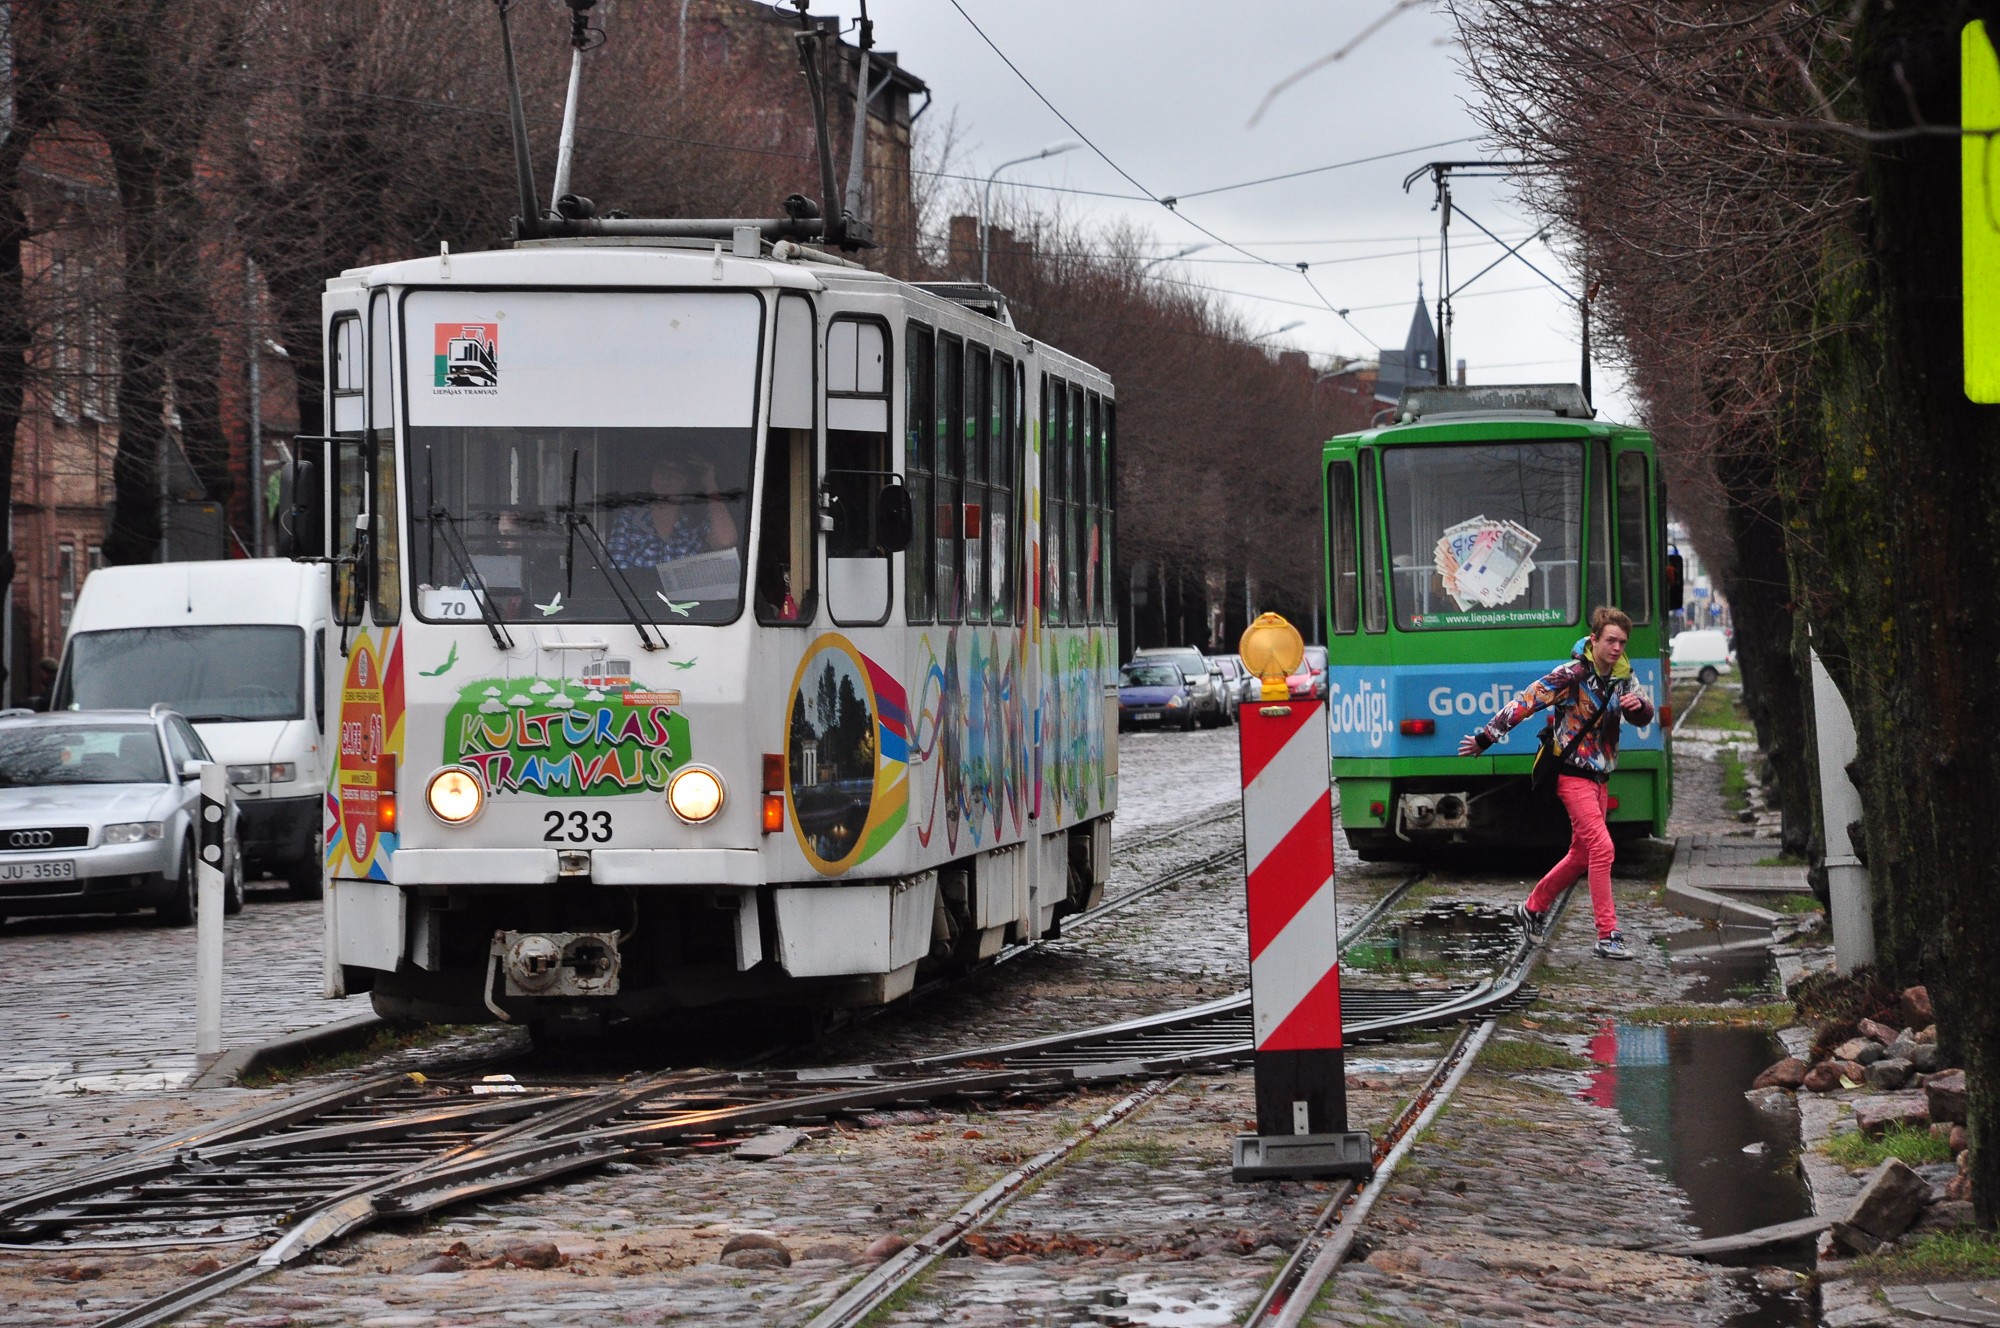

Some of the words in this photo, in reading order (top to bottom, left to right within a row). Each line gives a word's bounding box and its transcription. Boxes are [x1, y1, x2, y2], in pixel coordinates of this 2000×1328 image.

[441, 602, 466, 616] 70
[1445, 610, 1561, 625] www.liepajas-tramvajs.lv
[459, 706, 671, 754] KULTŪRAS
[1329, 679, 1393, 749] Godīgi.
[459, 746, 673, 792] TRAMVAJS
[543, 810, 613, 843] 233
[1, 862, 71, 880] JU-3569
